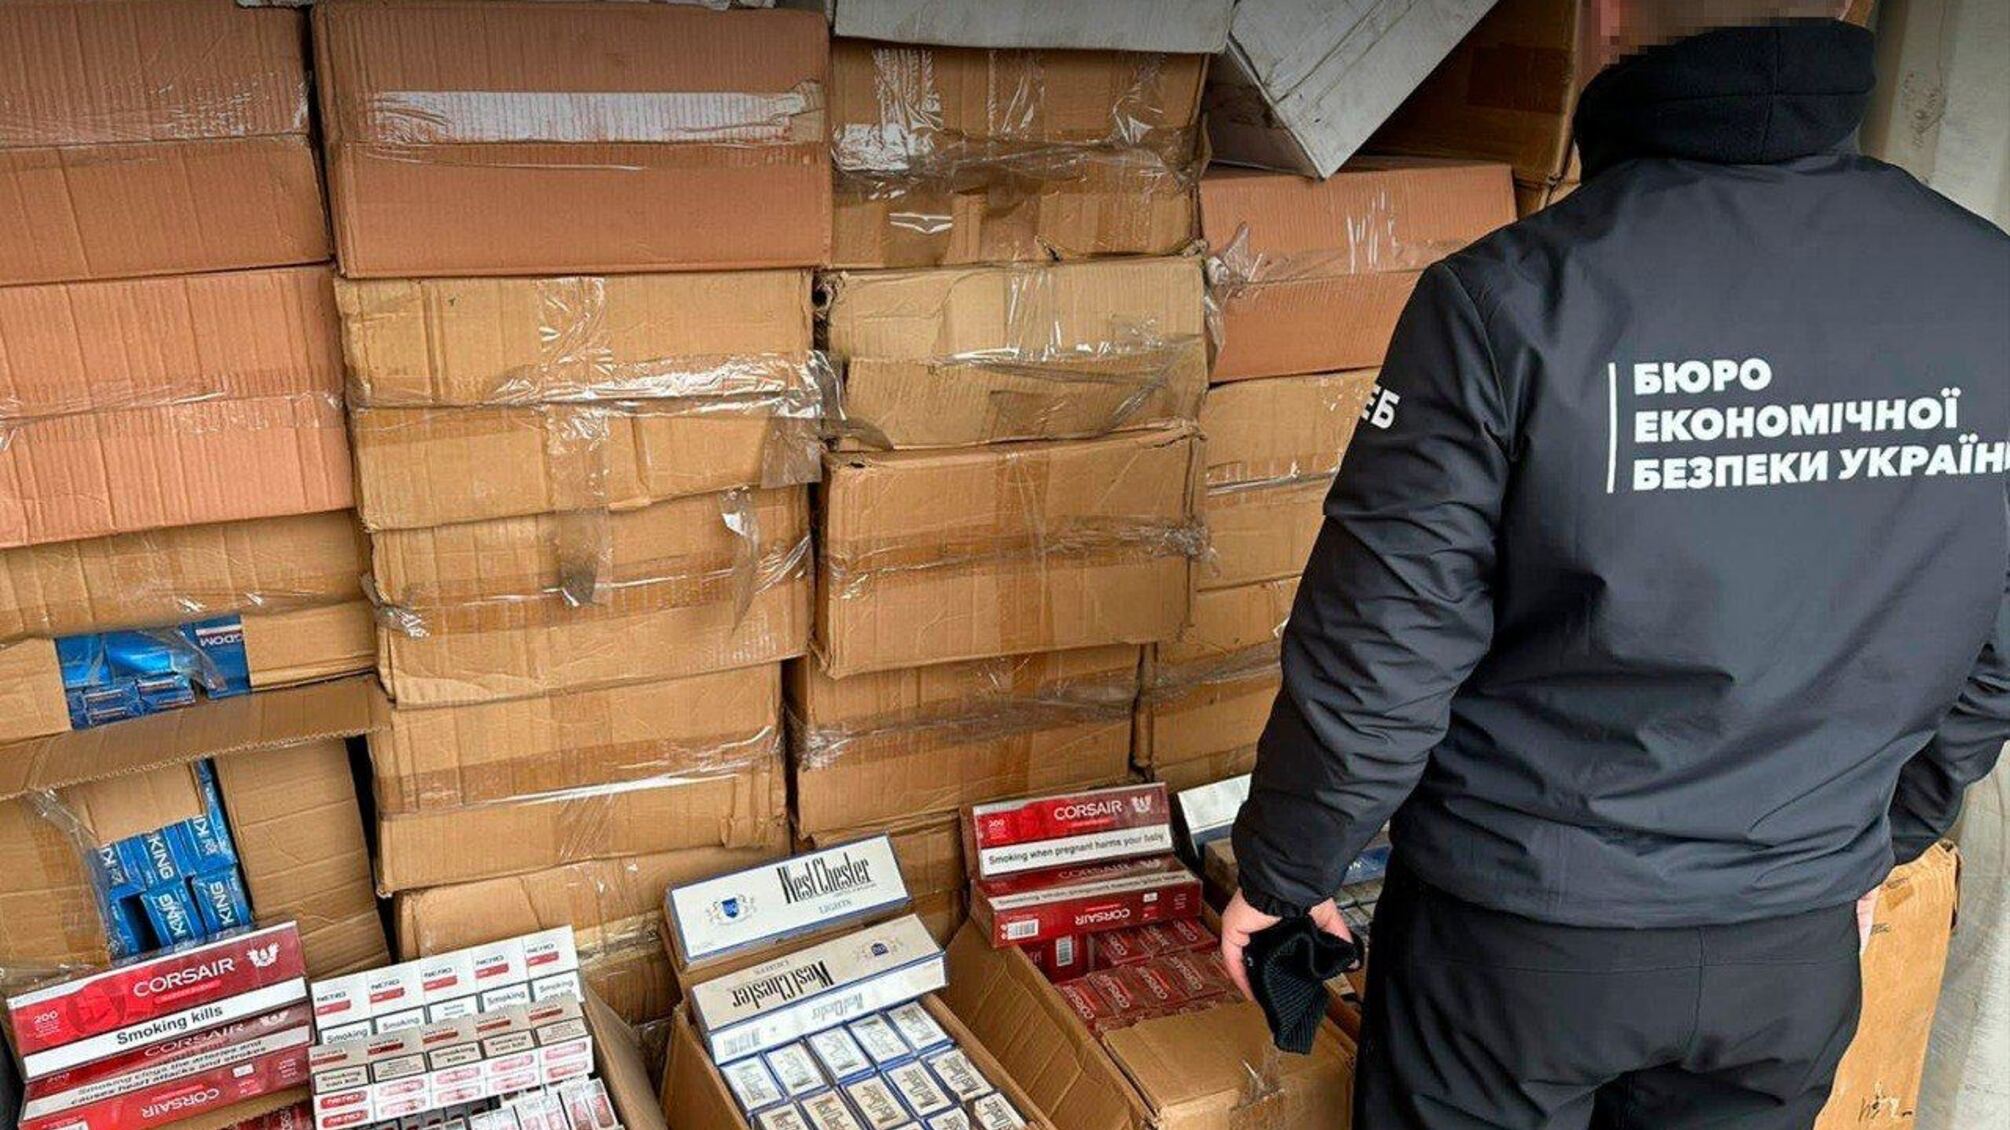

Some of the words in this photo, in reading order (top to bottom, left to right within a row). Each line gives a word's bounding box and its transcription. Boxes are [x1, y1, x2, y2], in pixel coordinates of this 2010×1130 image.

[1633, 357, 1773, 395] БЮРО
[1634, 387, 1962, 442] ЕКОНОМІЧНОЇ
[1632, 449, 1829, 491] БЕЗПЕКИ
[1838, 433, 2010, 480] УКРАЇН
[1053, 800, 1123, 821] CORSAIR
[148, 835, 175, 880] KING
[988, 848, 1028, 865] Smoking
[1030, 846, 1054, 859] when
[1055, 840, 1094, 857] pregnant
[1095, 836, 1122, 849] harms
[158, 893, 187, 936] KING
[210, 881, 236, 925] KING
[1075, 907, 1131, 926] CORSAIR
[133, 957, 236, 997] CORSAIR
[34, 1010, 59, 1024] 200
[117, 1017, 188, 1045] Smoking
[191, 1005, 223, 1024] kills
[144, 1023, 244, 1057] CORSAIR
[141, 1087, 220, 1119] CORSAIR
